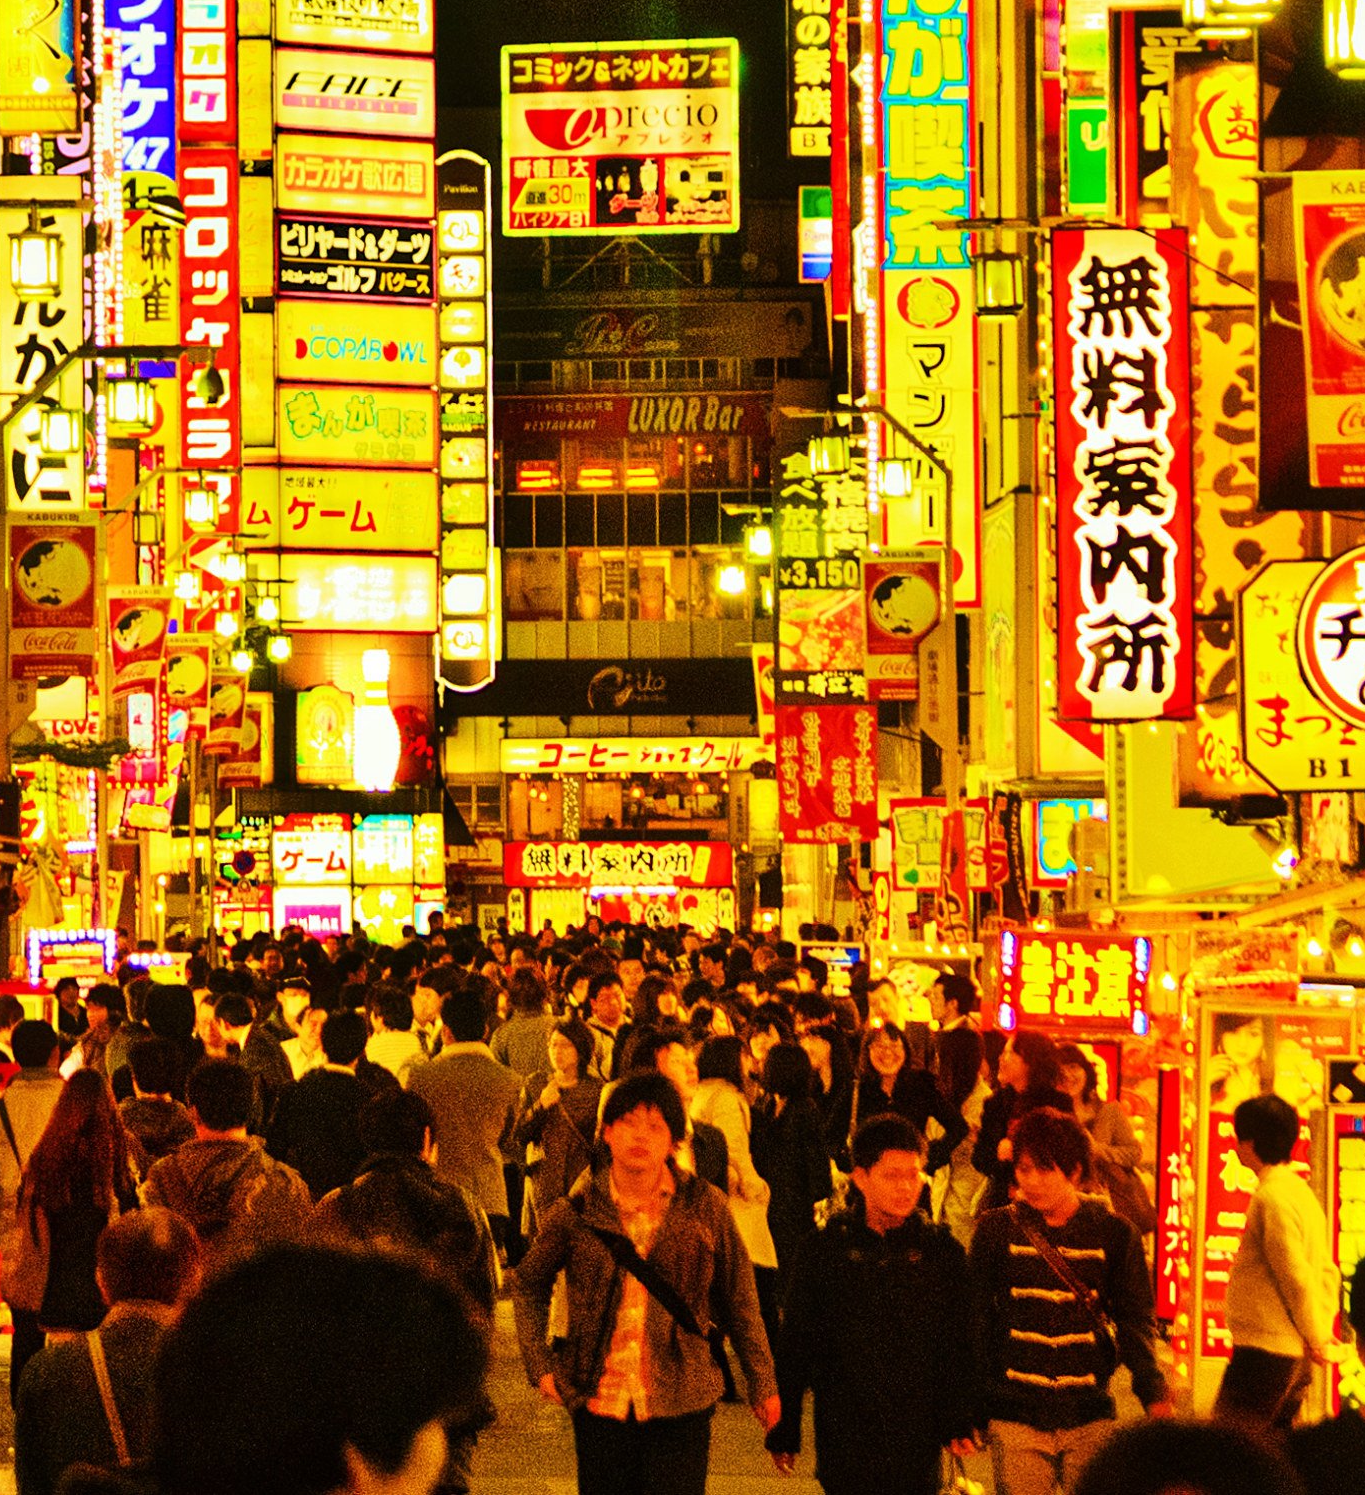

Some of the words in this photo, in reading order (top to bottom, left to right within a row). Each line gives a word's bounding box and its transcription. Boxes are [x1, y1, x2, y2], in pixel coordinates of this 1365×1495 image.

[513, 54, 730, 84] コミック&ネットカフェ
[285, 156, 423, 193] カラオケ歌広場
[281, 223, 430, 263] ビリヤード&ダーツ
[1079, 256, 1169, 693] 無料案内所
[288, 497, 377, 533] ゲーム
[1308, 759, 1352, 778] B1
[526, 847, 693, 875] 無料案内所
